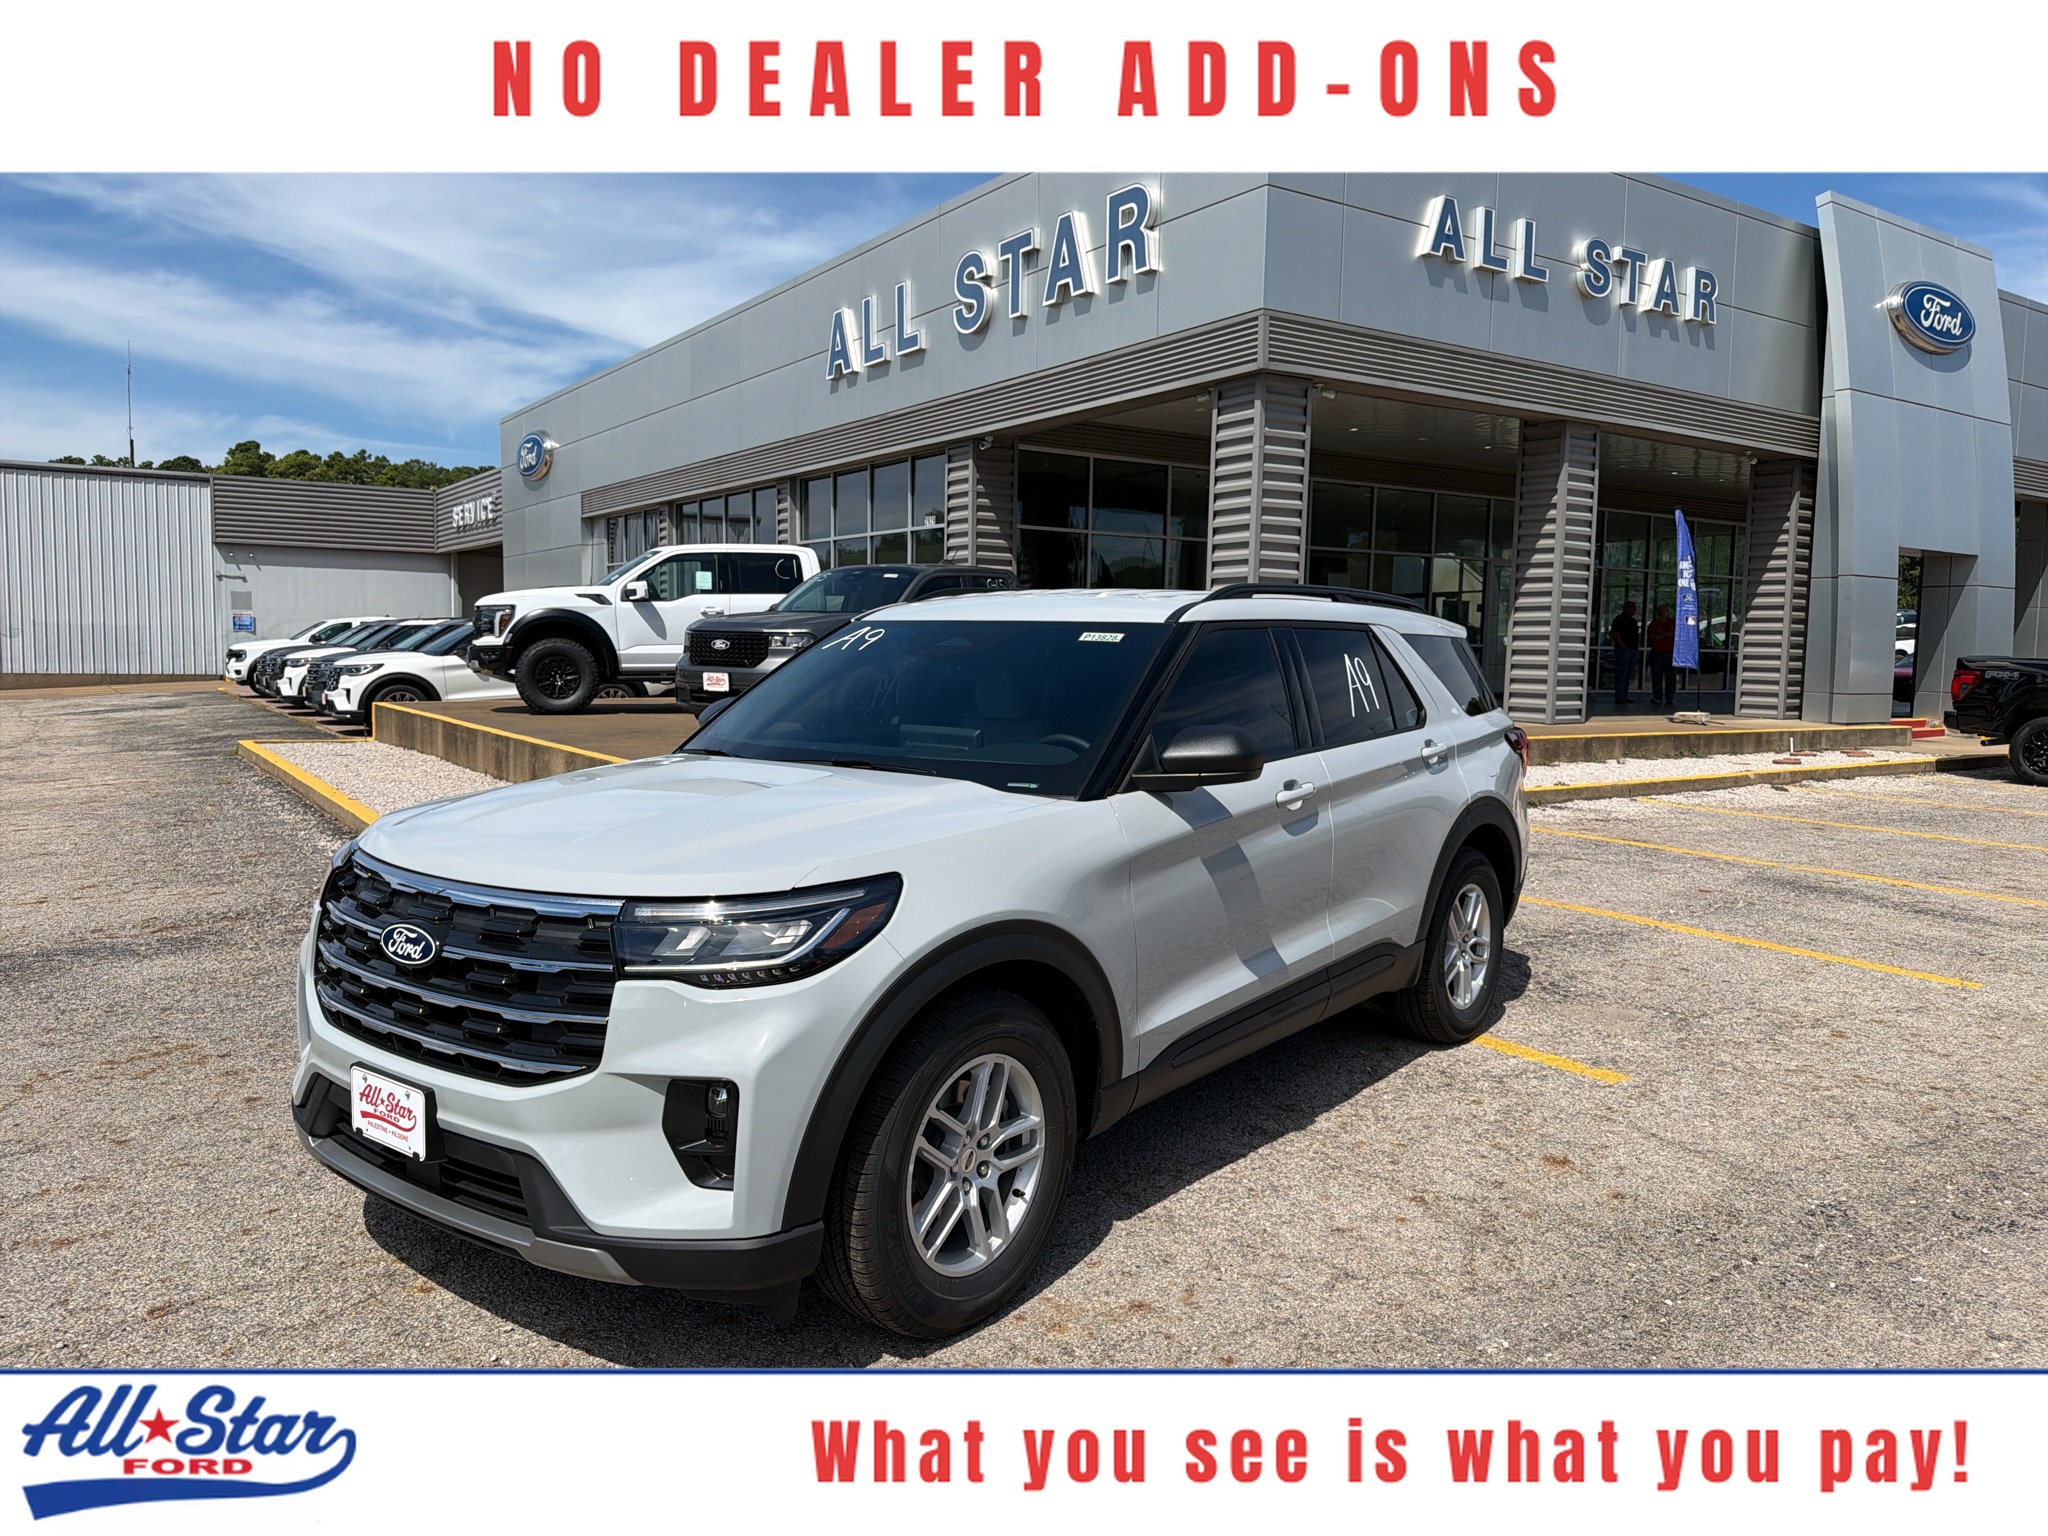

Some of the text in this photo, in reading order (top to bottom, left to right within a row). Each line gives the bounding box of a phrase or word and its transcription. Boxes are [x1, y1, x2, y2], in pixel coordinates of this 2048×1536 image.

[1421, 194, 1719, 325] ALL STAR
[826, 183, 1156, 380] ALL STAR
[1920, 294, 1963, 336] Ford
[452, 496, 495, 528] SERVICE
[822, 626, 885, 650] A9
[1344, 653, 1380, 718] A9
[1985, 670, 2020, 680] FX4
[388, 928, 426, 960] Ford
[359, 1084, 414, 1121] All Star
[373, 1108, 400, 1123] FORD
[367, 1120, 388, 1134] PALESTINE
